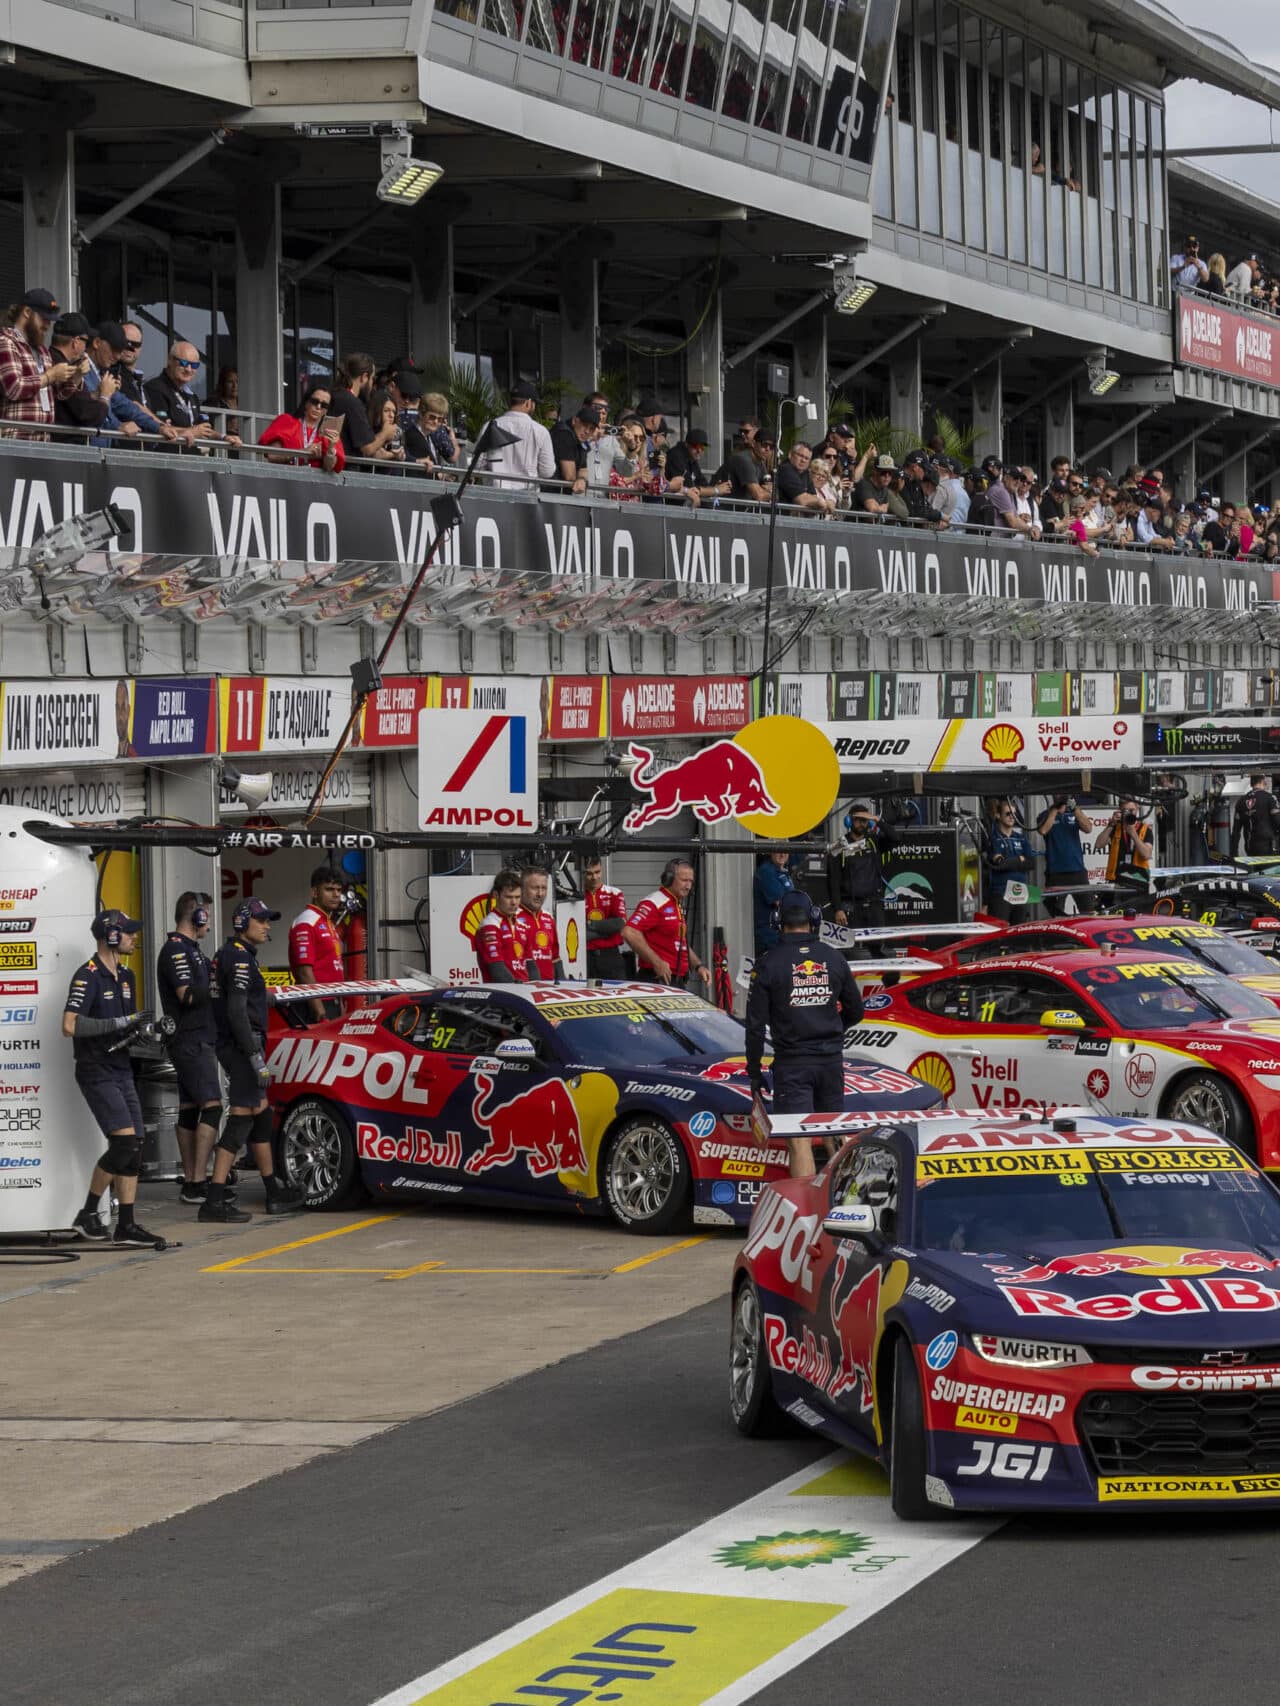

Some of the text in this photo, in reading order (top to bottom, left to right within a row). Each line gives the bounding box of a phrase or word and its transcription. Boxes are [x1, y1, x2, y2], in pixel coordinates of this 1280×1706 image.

[1193, 309, 1222, 346] ADELAIDE
[1246, 326, 1272, 361] ADELAIDE
[158, 691, 187, 716] RED BULL
[376, 689, 391, 710] SHELL
[637, 684, 675, 712] ADELAIDE
[707, 683, 745, 711] ADELAIDE
[7, 693, 100, 751] VAN GISBERGEN
[236, 689, 332, 747] 11 DE PASQUALE
[378, 713, 411, 735] RACING TEAM
[636, 714, 676, 728] SOUTH AUSTRALIA
[1038, 722, 1069, 734] Shell
[149, 718, 194, 745] AMPOL RACING
[1184, 732, 1242, 743] MONSTER
[834, 738, 910, 760] Repco
[1039, 736, 1121, 751] V-Power
[1043, 755, 1069, 763] Racing
[20, 781, 121, 816] GARAGE DOORS
[425, 807, 533, 827] AMPOL
[227, 832, 376, 849] #AIR ALLIED
[892, 844, 942, 854] MONSTER
[884, 901, 934, 909] SNOWY RIVER
[1200, 912, 1217, 927] 43
[449, 968, 479, 979] Shell
[1116, 962, 1217, 979] PIRTEK
[790, 986, 832, 996] AMPOL
[1, 1009, 34, 1022] JGI
[538, 1000, 639, 1019] NATIONAL
[980, 1001, 996, 1022] 11
[0, 1040, 40, 1050] ÜRTH
[431, 1027, 456, 1048] 97
[1078, 1042, 1109, 1051] VAILO
[265, 1038, 428, 1104] AMPOL
[971, 1056, 1018, 1081] Shell
[624, 1081, 696, 1101] ToolPRO
[924, 1128, 1222, 1152] AMPOL
[726, 1163, 761, 1174] AUTO
[919, 1151, 1237, 1176] NATIONAL STORAGE
[1058, 1172, 1210, 1186] 88 Feeney
[905, 1276, 957, 1313] ToolPRO
[929, 1332, 956, 1369] hp
[1001, 1341, 1077, 1362] WÜRTH
[931, 1376, 1066, 1420] SUPERCHEAP
[962, 1411, 1012, 1428] AUTO
[956, 1440, 1054, 1481] JGI
[1105, 1481, 1230, 1494] NATIONAL
[848, 1554, 911, 1573] bp
